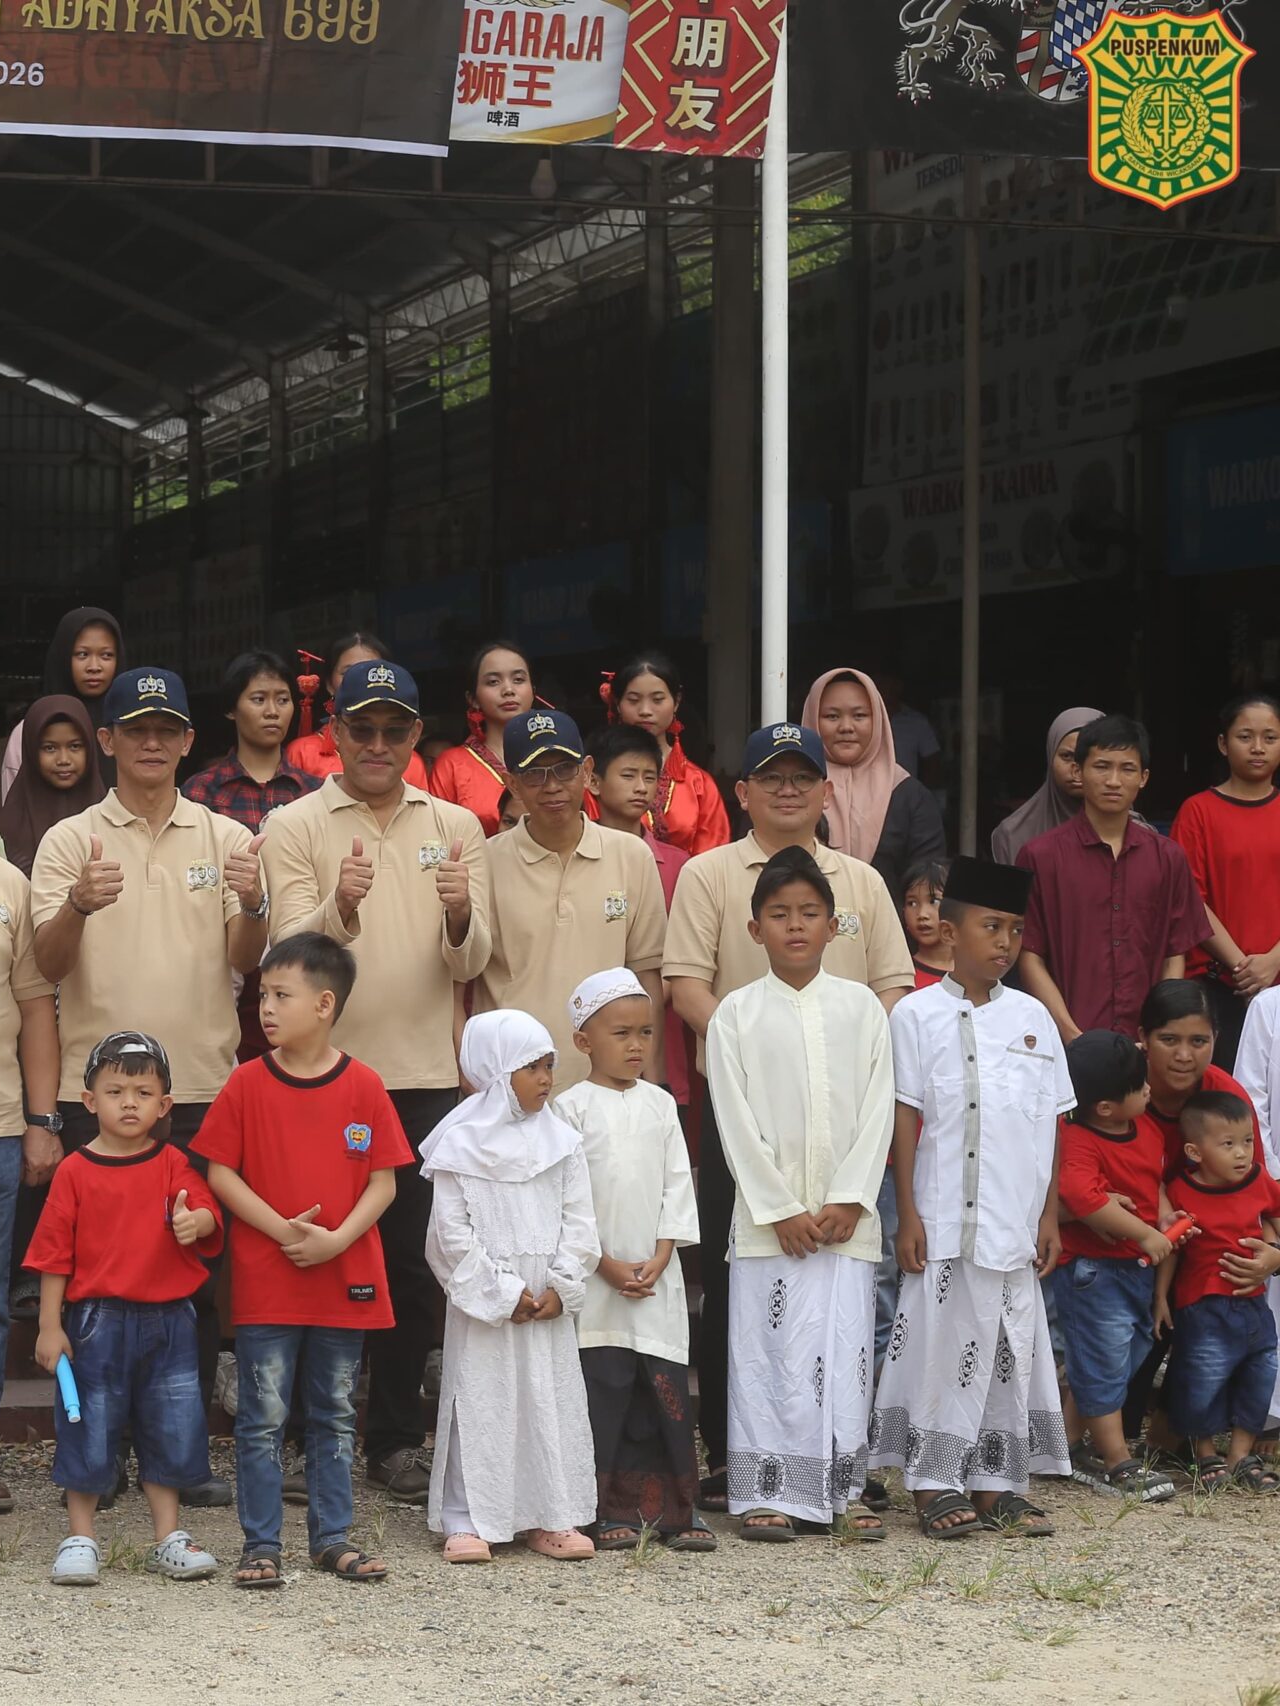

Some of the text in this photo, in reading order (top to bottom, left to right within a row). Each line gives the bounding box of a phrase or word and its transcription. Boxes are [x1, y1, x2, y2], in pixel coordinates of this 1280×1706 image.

[284, 0, 380, 45] 699
[459, 8, 605, 62] GARAJA
[457, 60, 556, 108] 狮王
[665, 18, 727, 131] 朋友
[486, 110, 520, 128] 啤酒
[916, 155, 965, 192] TERSEDI
[901, 473, 987, 519] WARKP
[137, 677, 167, 693] 699
[368, 666, 396, 684] 699
[527, 715, 555, 732] 699
[772, 726, 801, 740] 699
